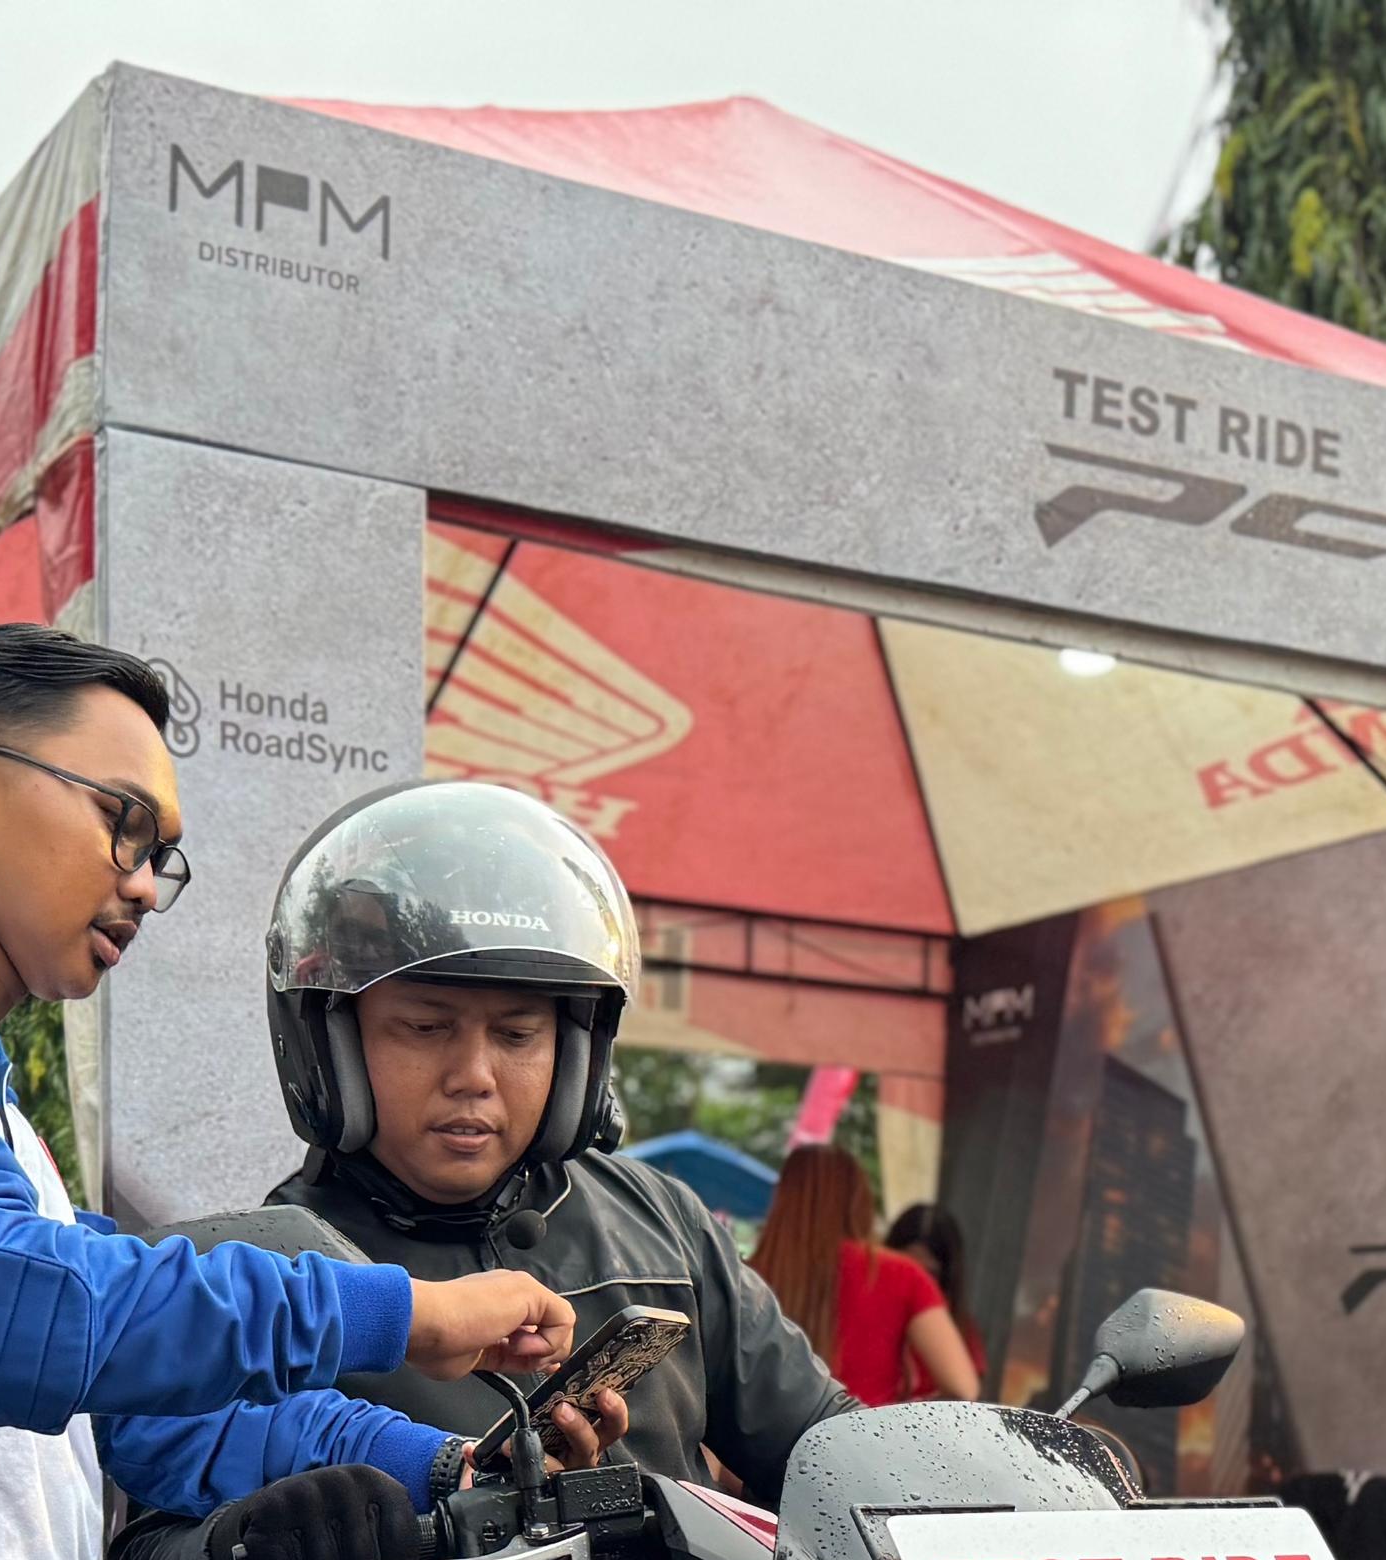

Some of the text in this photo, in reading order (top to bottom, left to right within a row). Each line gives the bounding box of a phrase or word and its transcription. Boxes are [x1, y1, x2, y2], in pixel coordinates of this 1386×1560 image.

[169, 143, 390, 261] MPM
[199, 241, 360, 294] DISTRIBUTOR
[1052, 367, 1341, 478] TEST RIDE
[219, 679, 328, 724] Honda
[219, 720, 389, 774] RoadSync
[450, 910, 552, 932] HONDA
